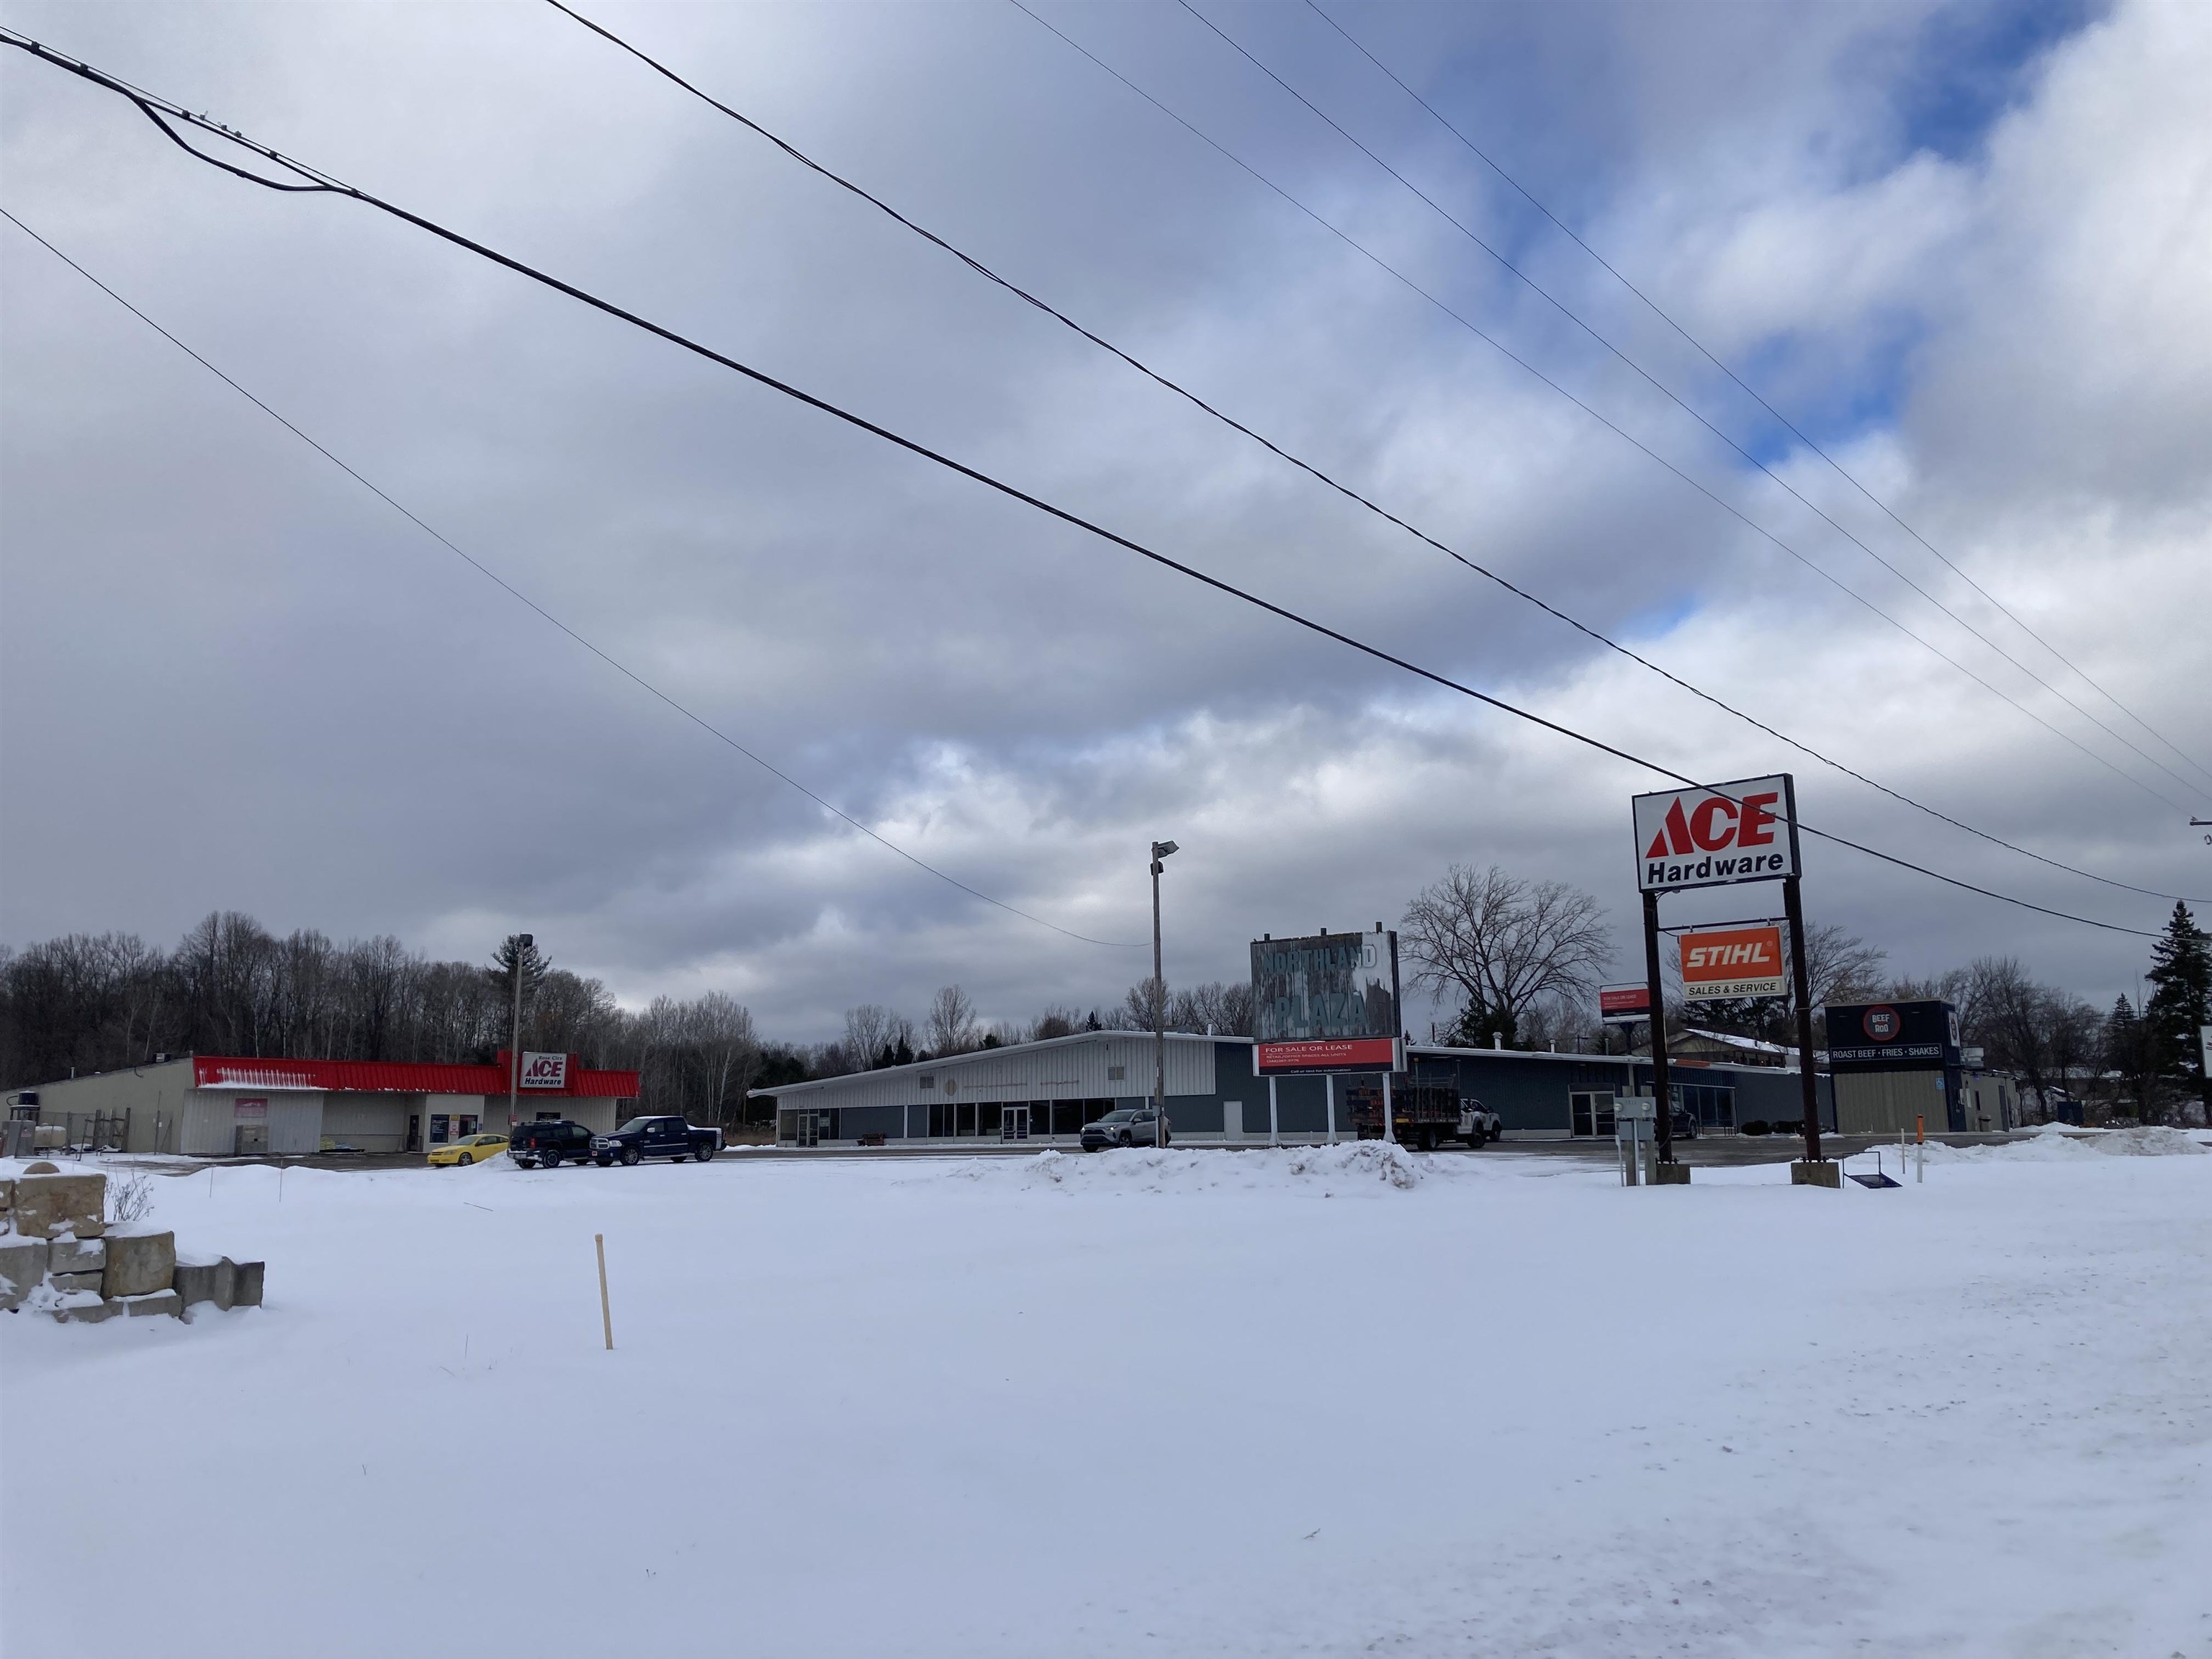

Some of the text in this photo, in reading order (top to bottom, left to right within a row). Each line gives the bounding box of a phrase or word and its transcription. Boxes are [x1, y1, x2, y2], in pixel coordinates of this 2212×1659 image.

[1645, 792, 1778, 858] ACE
[1647, 853, 1784, 884] Hardware
[1262, 944, 1377, 973] NORTHLAND
[1686, 942, 1770, 968] STIHL
[1689, 985, 1720, 996] SALES
[1732, 983, 1776, 993] SERVICE
[1274, 991, 1367, 1029] PLAZA
[1872, 1014, 1890, 1022] BEEF
[1833, 1050, 1857, 1058] ROAST
[1881, 1048, 1903, 1057] FRIES
[1909, 1047, 1939, 1056] SHAKES
[525, 1058, 562, 1077] ACE
